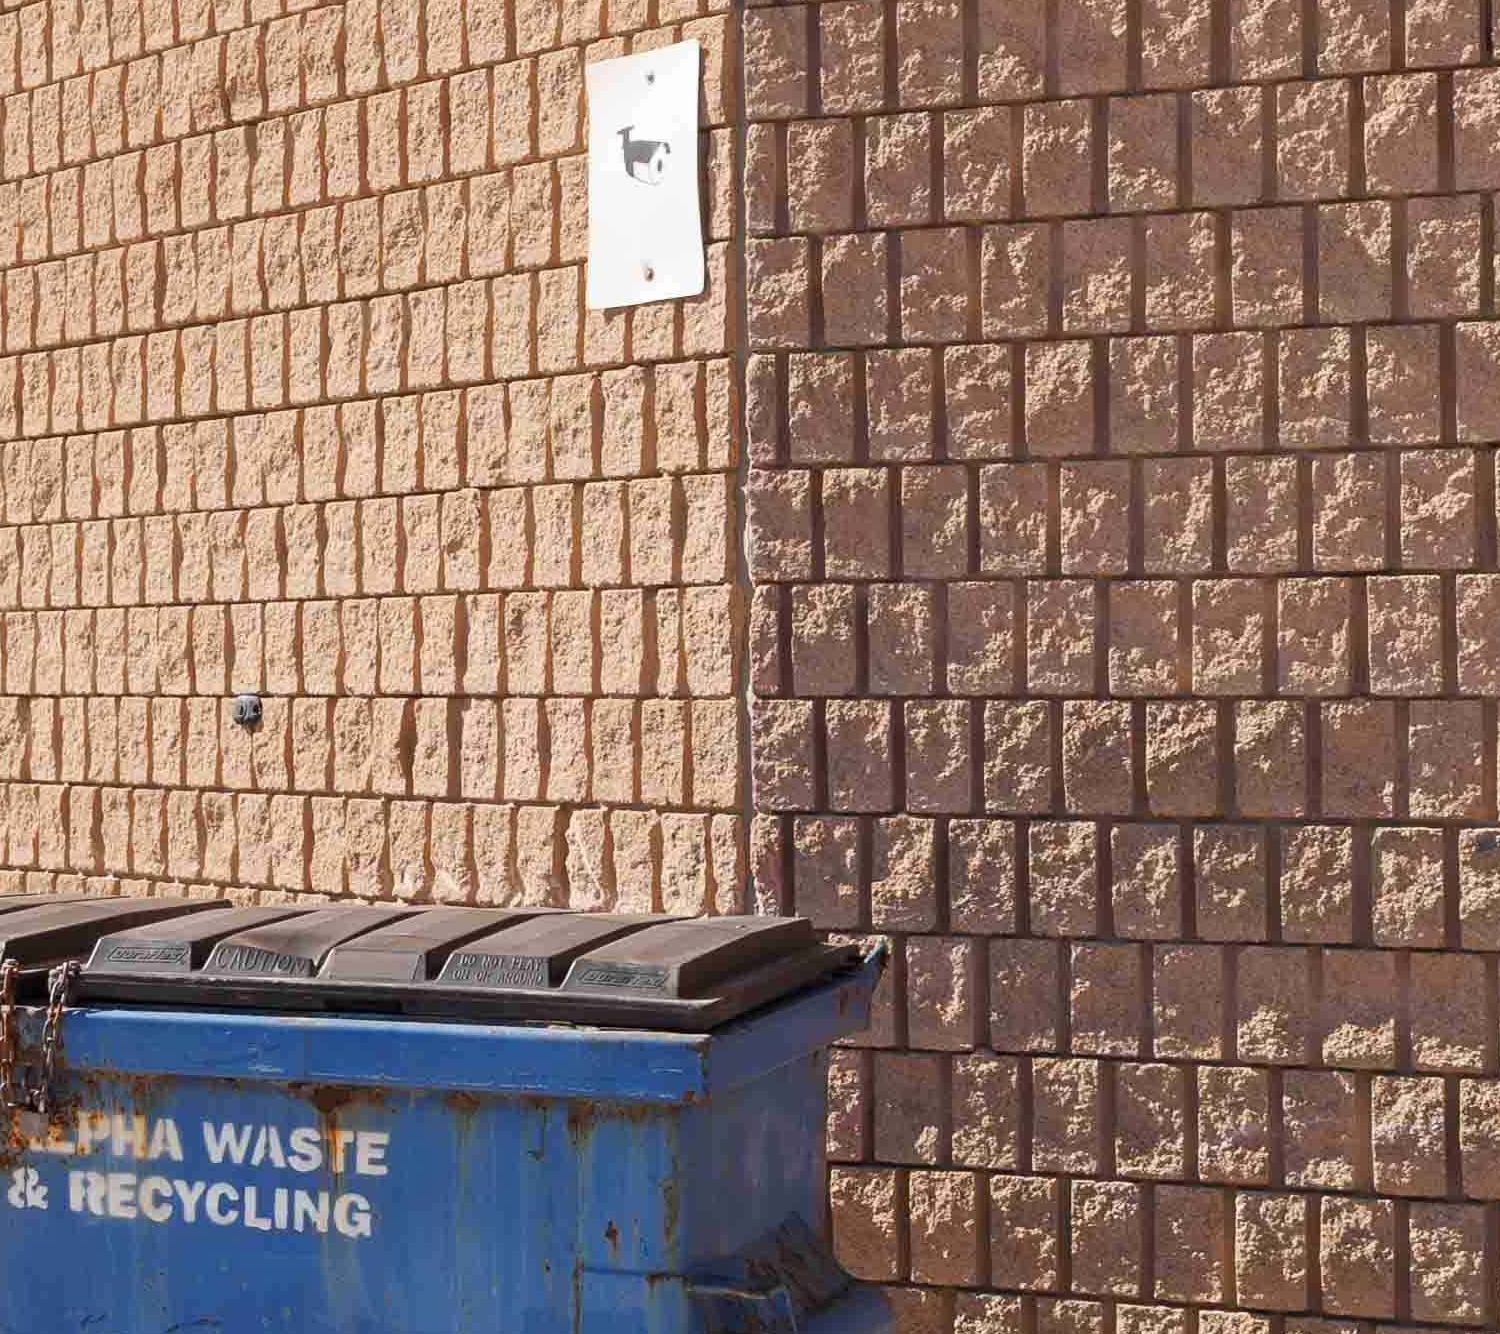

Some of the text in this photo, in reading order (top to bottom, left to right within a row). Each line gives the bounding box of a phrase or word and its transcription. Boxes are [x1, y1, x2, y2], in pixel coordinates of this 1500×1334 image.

[8, 1105, 391, 1177] LPHA WASTE
[6, 1167, 374, 1239] & RECYCLING
